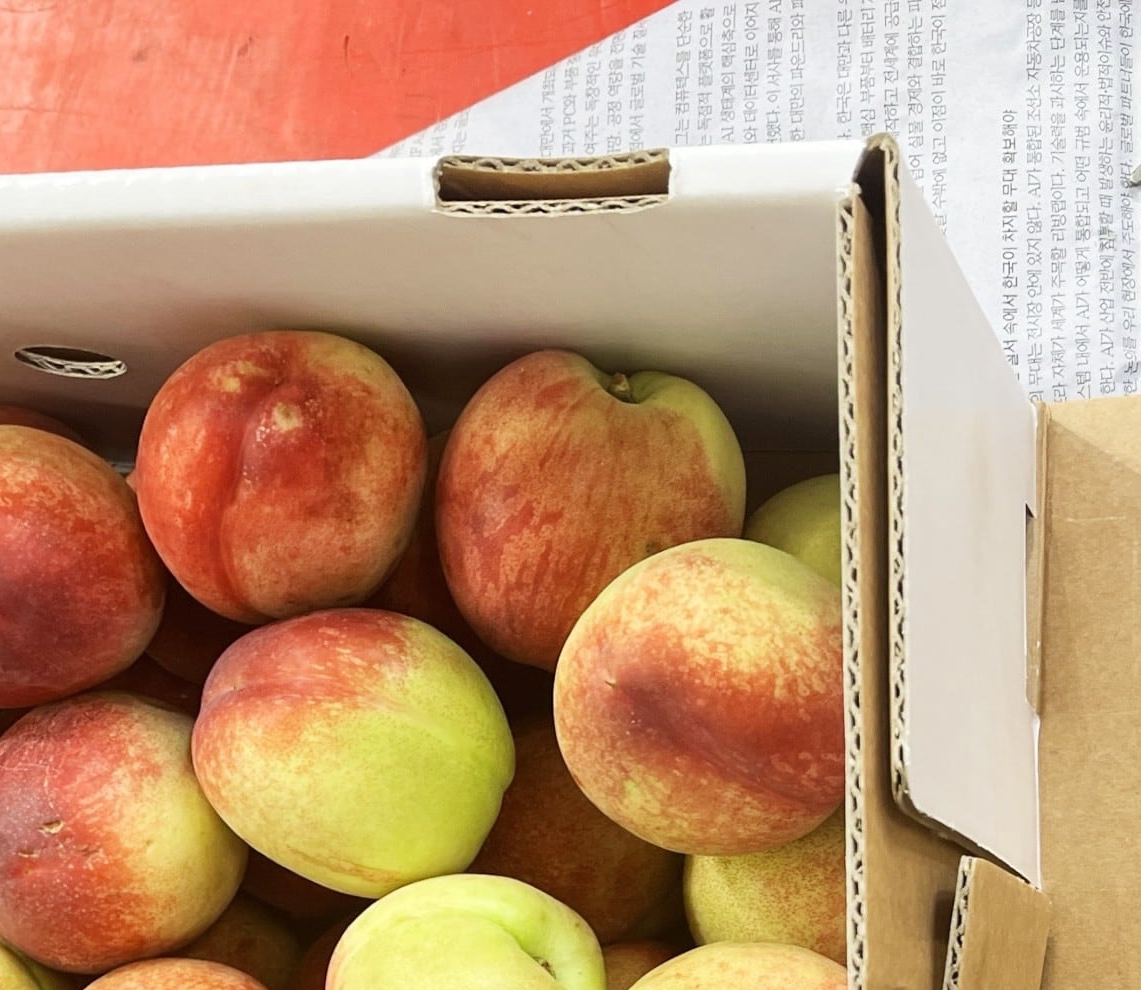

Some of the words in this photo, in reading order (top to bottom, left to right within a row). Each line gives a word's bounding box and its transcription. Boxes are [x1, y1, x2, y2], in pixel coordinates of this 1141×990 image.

[884, 0, 899, 27] 공급
[1050, 9, 1066, 50] 단계를
[930, 15, 946, 54] 한국이
[1026, 13, 1042, 80] 자동차공장
[1050, 55, 1066, 109] 과시하는
[1119, 42, 1133, 110] 파트너들이
[837, 82, 852, 124] 한국은
[885, 88, 899, 136] 작하고
[1027, 84, 1042, 121] 조선소
[1075, 82, 1089, 122] 속에서
[1002, 110, 1018, 164] 확보해야
[1027, 125, 1042, 164] 통합된
[1050, 112, 1066, 163] 기술력을
[1119, 112, 1134, 154] 글로벌
[1003, 168, 1018, 196] 무대
[1075, 156, 1090, 183] 어떤
[1098, 136, 1113, 190] 발생하는
[1002, 201, 1017, 242] 차지할
[1075, 187, 1090, 242] 통합되고
[1002, 247, 1018, 288] 한국이
[1027, 238, 1042, 265] 있지
[1051, 247, 1067, 288] 주목할
[1075, 247, 1091, 287] 어떻게
[1027, 270, 1042, 297] 안에
[1099, 254, 1114, 294] 전반에
[1122, 249, 1136, 302] 현장에서
[1002, 294, 1018, 335] 속에서
[1027, 301, 1042, 340] 전시장
[1051, 292, 1067, 331] 세계가
[1076, 291, 1090, 319] AI가
[1099, 298, 1115, 323] 산업
[1122, 306, 1136, 332] 우리
[1051, 335, 1067, 377] 자체가
[1076, 325, 1091, 366] 내에서
[1100, 327, 1115, 357] AI가
[1027, 343, 1043, 385] 무대는
[1100, 362, 1115, 394] 한다.
